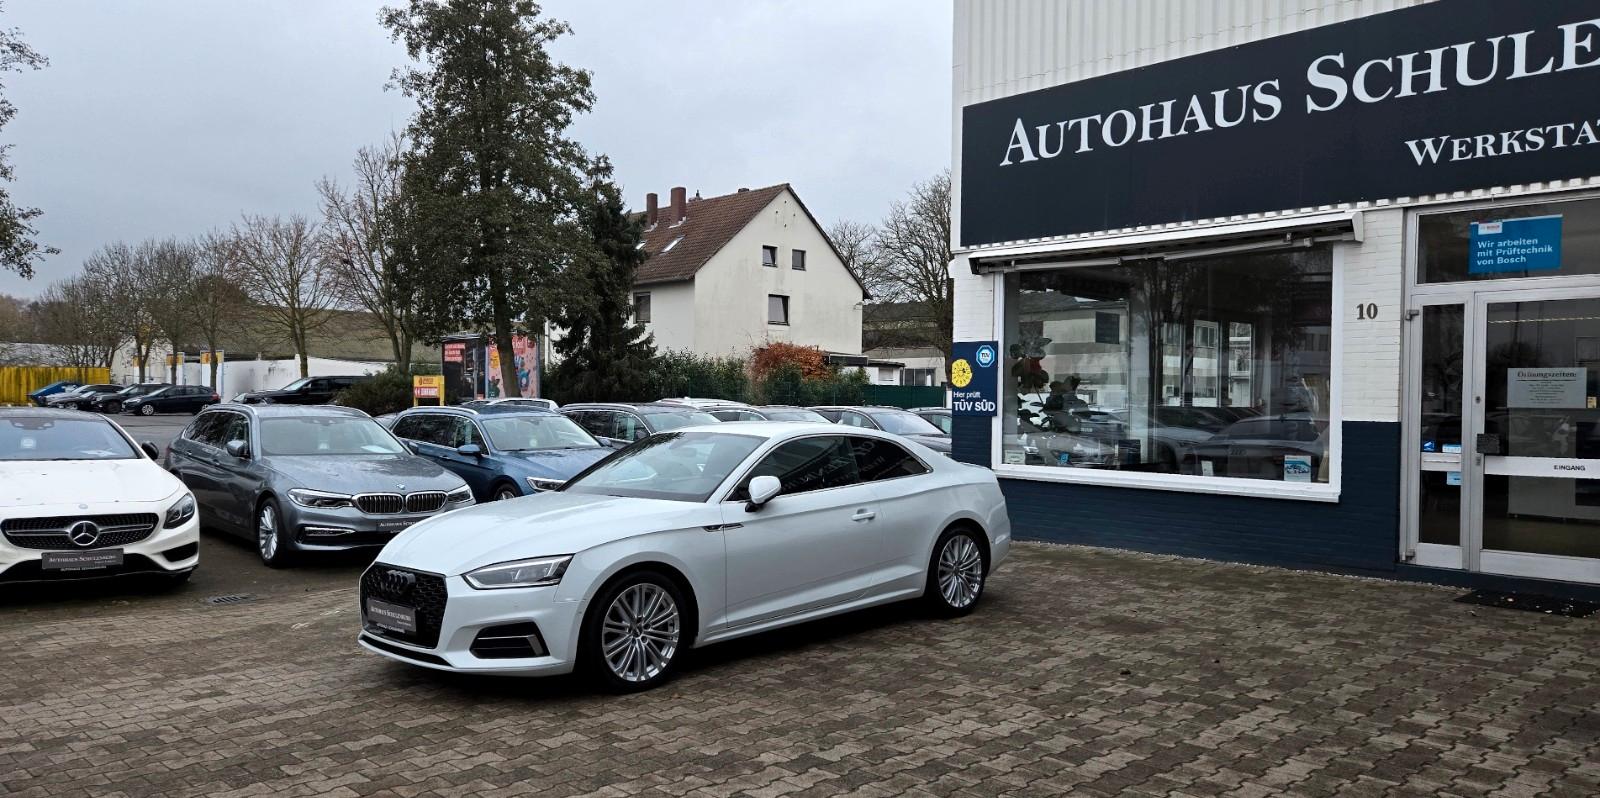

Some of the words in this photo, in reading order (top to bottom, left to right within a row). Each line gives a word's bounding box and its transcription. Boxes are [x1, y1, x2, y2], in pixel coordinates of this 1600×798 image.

[999, 79, 1282, 166] AUTOHAUS
[1497, 238, 1539, 247] arbeiten
[1496, 244, 1553, 256] Prüftechnik
[1497, 255, 1527, 264] Bosch
[1357, 303, 1378, 320] 10
[966, 391, 981, 399] prüft
[953, 400, 973, 411] TÜV
[974, 400, 996, 412] SÜD
